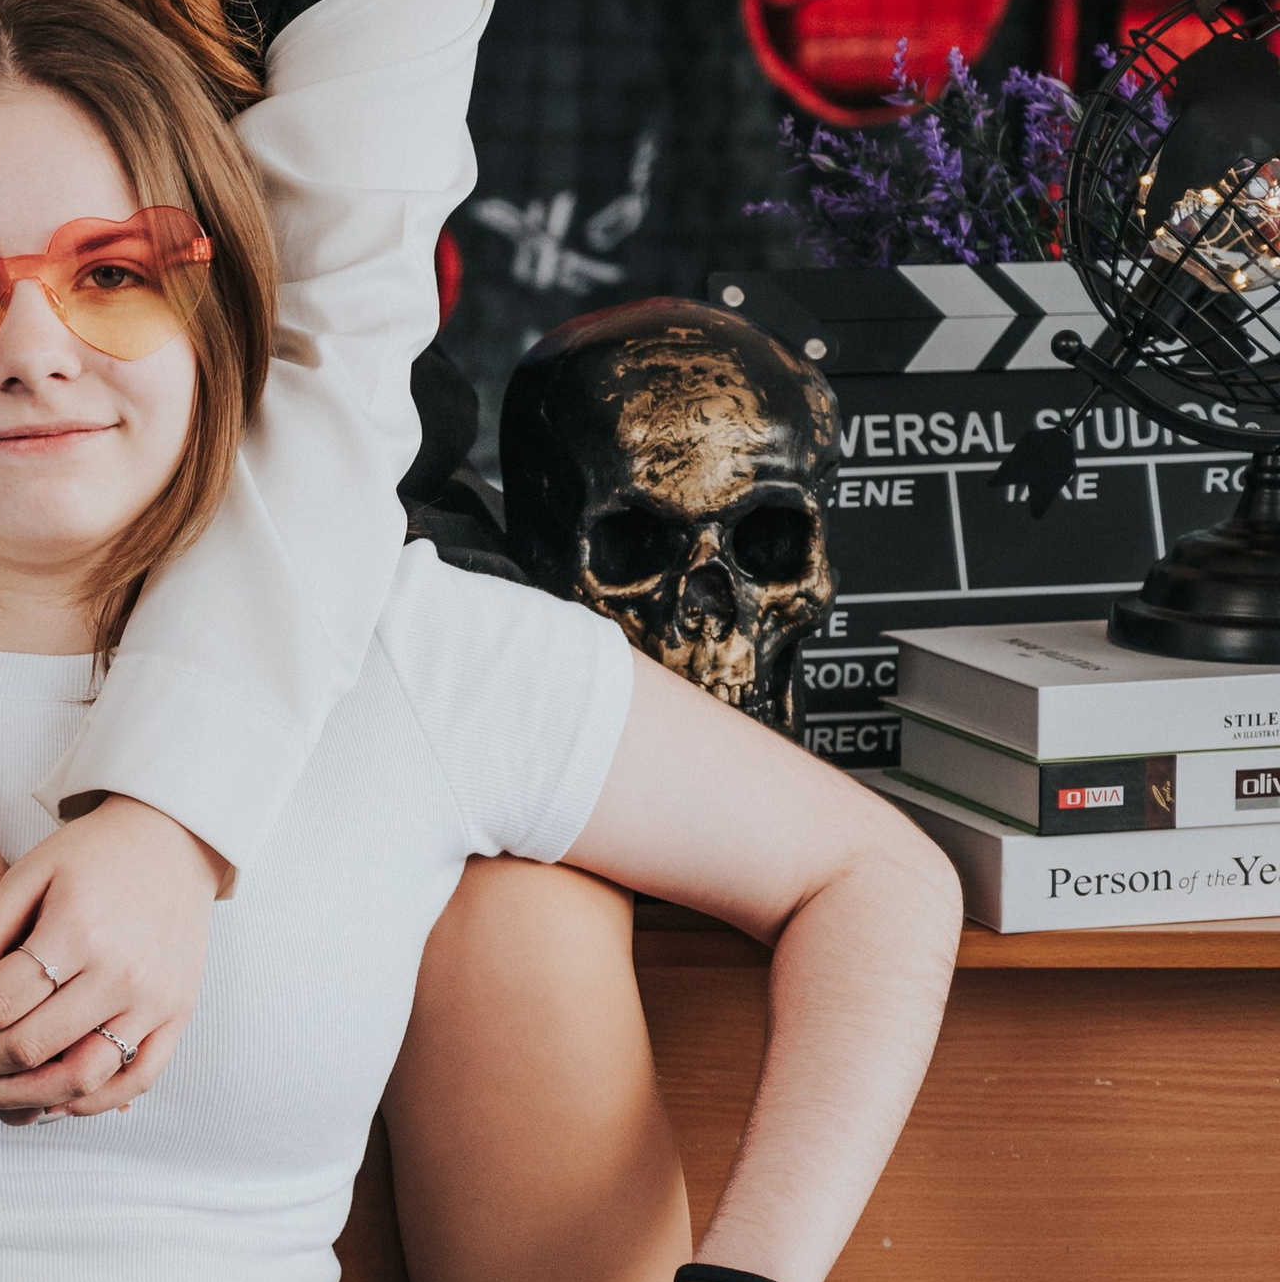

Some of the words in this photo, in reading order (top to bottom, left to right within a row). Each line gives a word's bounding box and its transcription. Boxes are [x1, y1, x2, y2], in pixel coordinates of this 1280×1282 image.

[827, 479, 915, 508] ENE
[1223, 711, 1279, 729] STILE
[1047, 867, 1173, 900] Person
[1178, 869, 1200, 895] of
[1207, 869, 1238, 888] the
[1231, 855, 1280, 888] Ye
